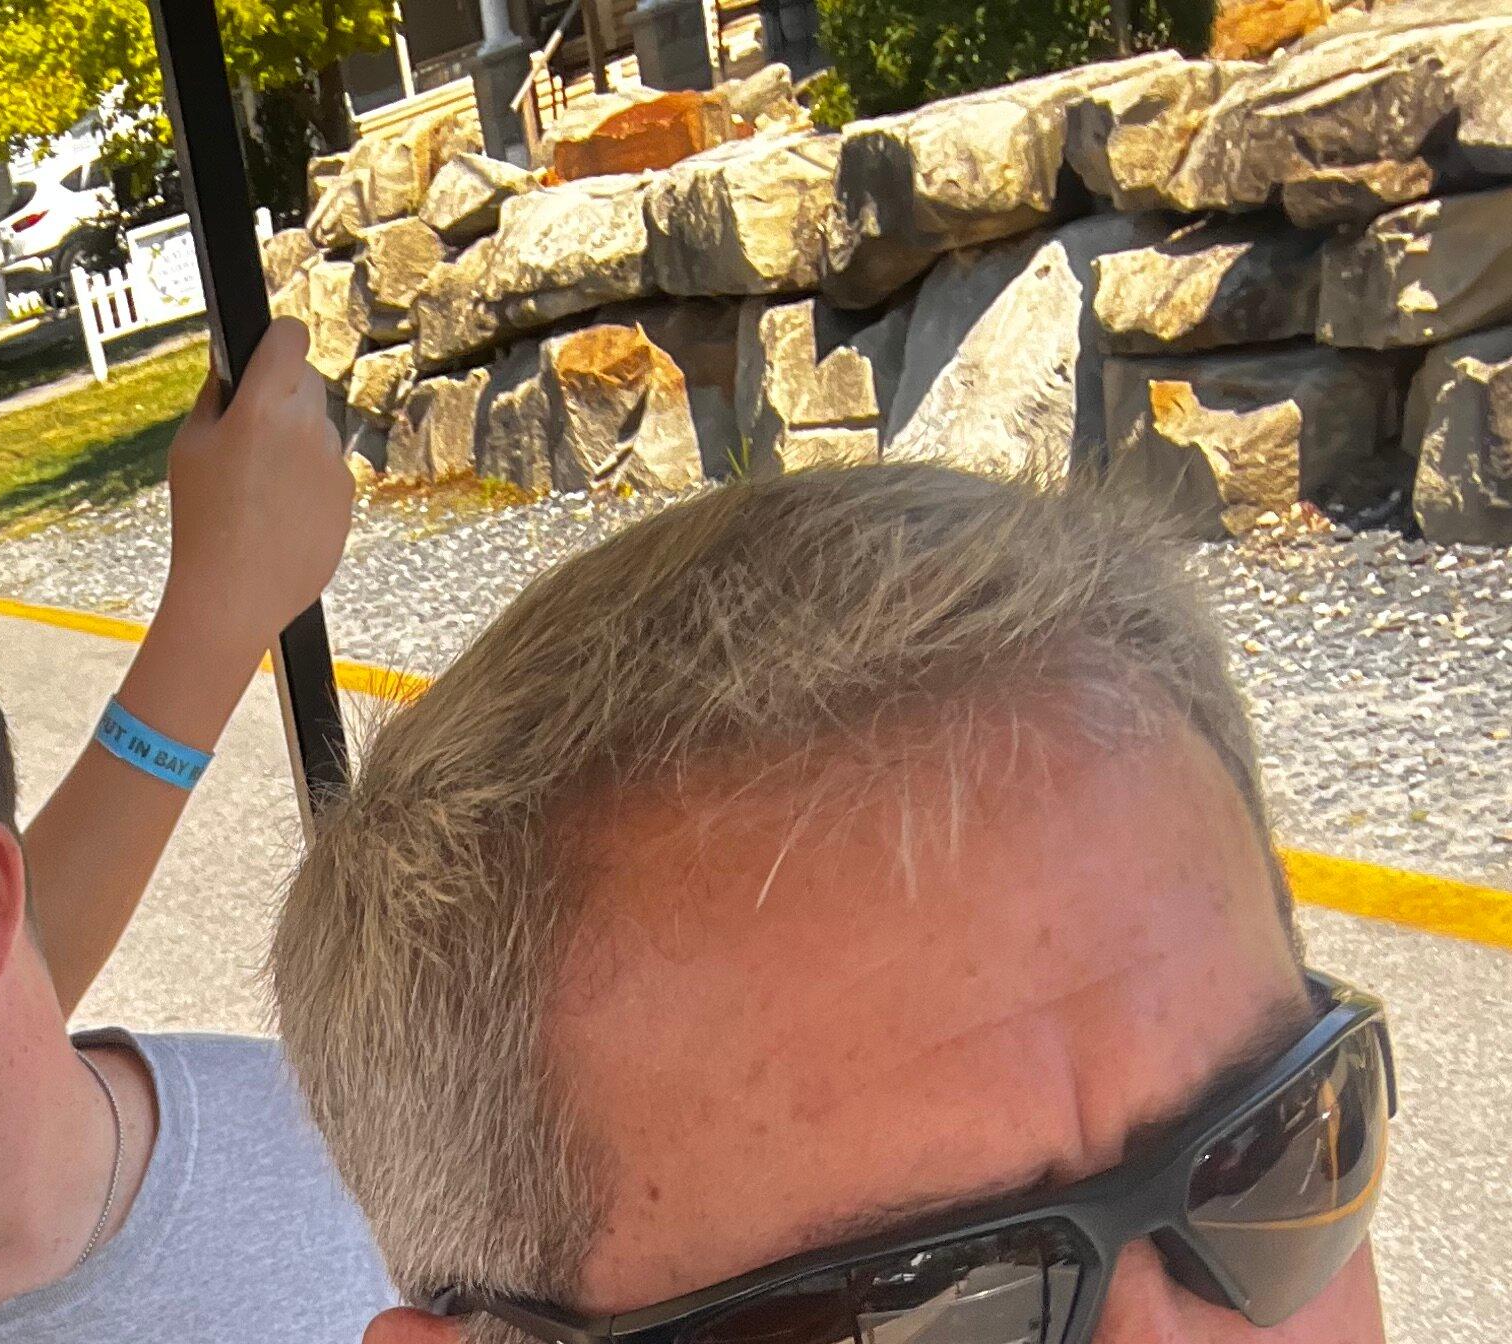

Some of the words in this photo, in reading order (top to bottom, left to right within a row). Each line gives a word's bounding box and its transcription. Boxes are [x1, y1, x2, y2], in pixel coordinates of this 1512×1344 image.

[100, 715, 128, 743] UT
[128, 736, 151, 759] IN
[153, 750, 190, 775] BAY
